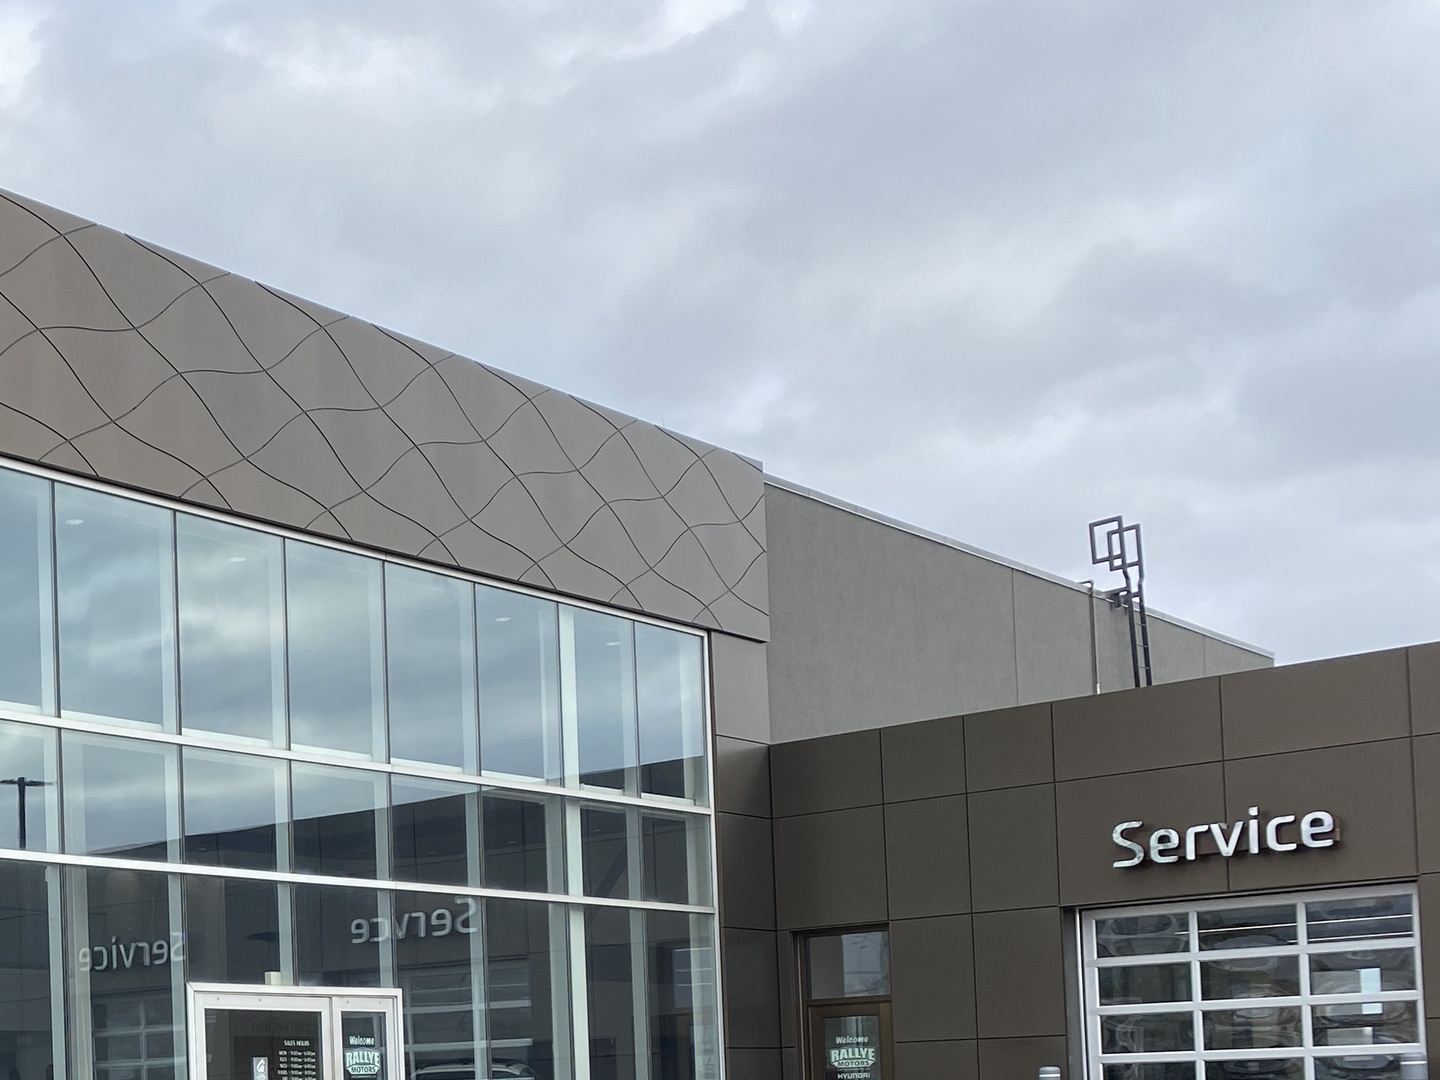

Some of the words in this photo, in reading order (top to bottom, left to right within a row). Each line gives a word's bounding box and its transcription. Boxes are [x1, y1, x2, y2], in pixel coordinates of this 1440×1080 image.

[1112, 805, 1335, 868] Service
[349, 1035, 375, 1046] Welcome
[835, 1035, 869, 1044] Welcome
[345, 1050, 380, 1068] RALLYE
[831, 1047, 876, 1062] RALLYE
